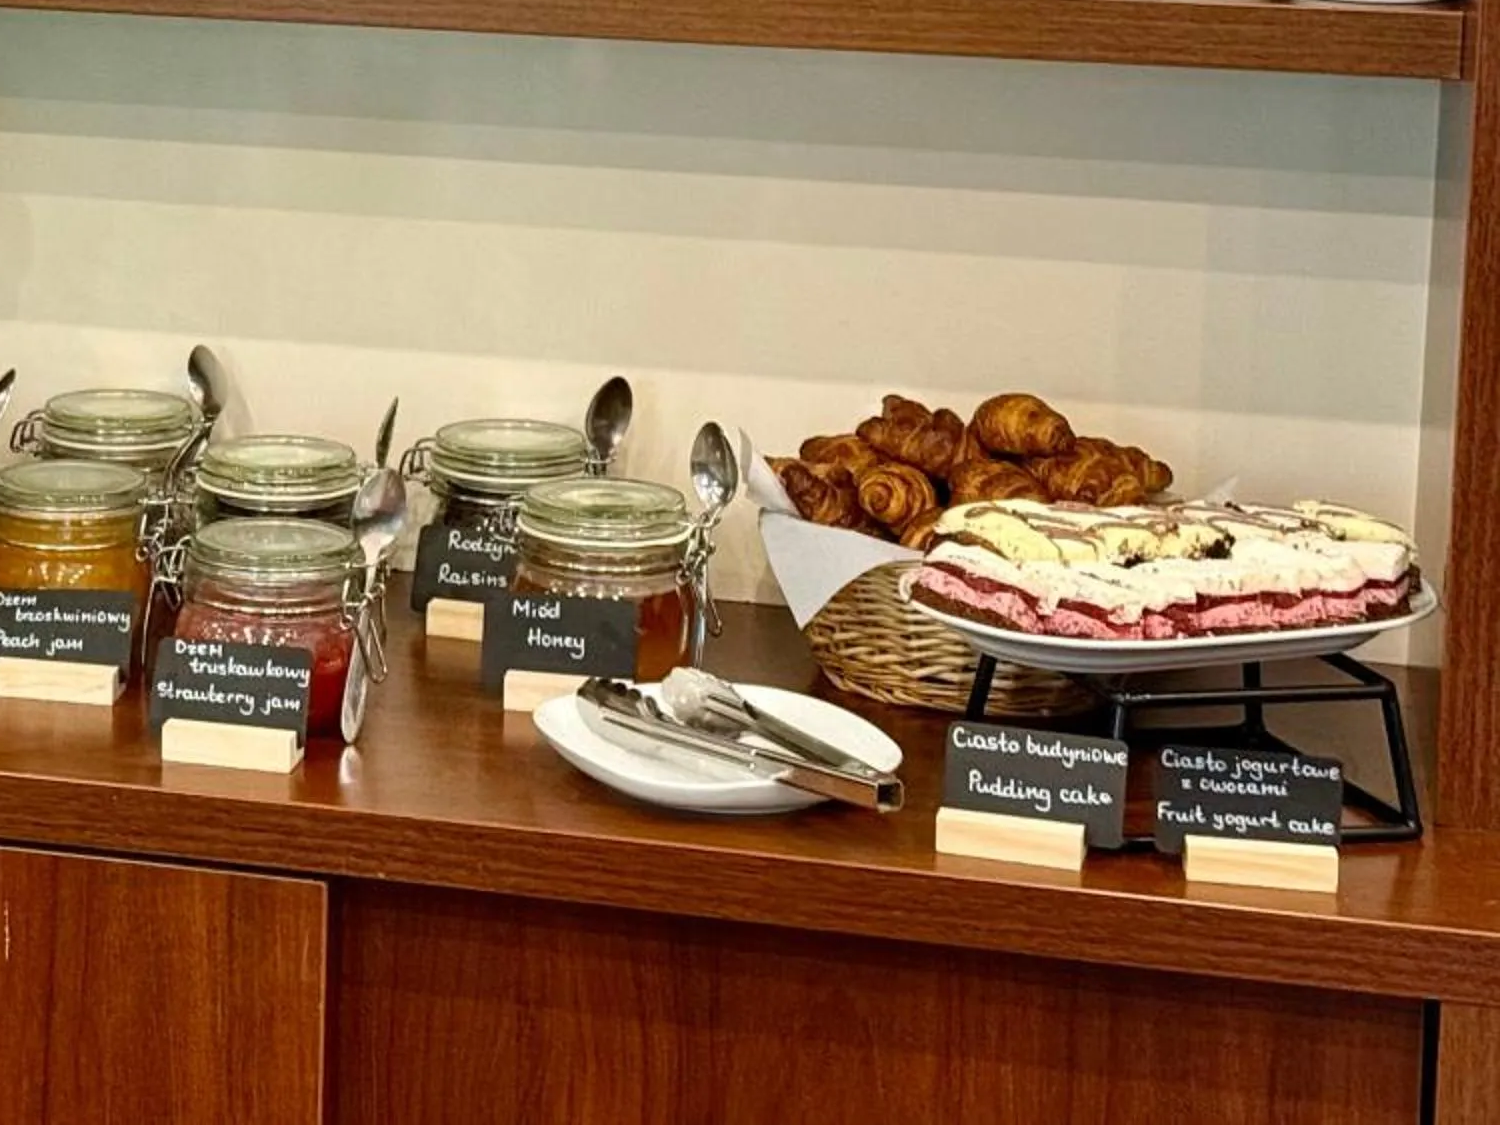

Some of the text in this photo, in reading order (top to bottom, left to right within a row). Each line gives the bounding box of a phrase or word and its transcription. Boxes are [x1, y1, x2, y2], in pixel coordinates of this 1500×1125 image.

[447, 528, 520, 562] Rodzyn
[437, 562, 508, 588] Raisins
[15, 606, 131, 633] brzoskwiniowy
[511, 599, 561, 621] Miód
[45, 635, 84, 657] jam
[527, 627, 586, 660] Honey
[188, 655, 312, 688] truskawkowy
[259, 693, 302, 716] jam
[952, 725, 1129, 769] Ciasto budyniowe
[1160, 748, 1342, 782] Ciasto jogurtowe
[968, 768, 1114, 813] Pudding cake
[1198, 777, 1290, 797] owocami
[1156, 800, 1337, 836] Fruit yogurt cake
